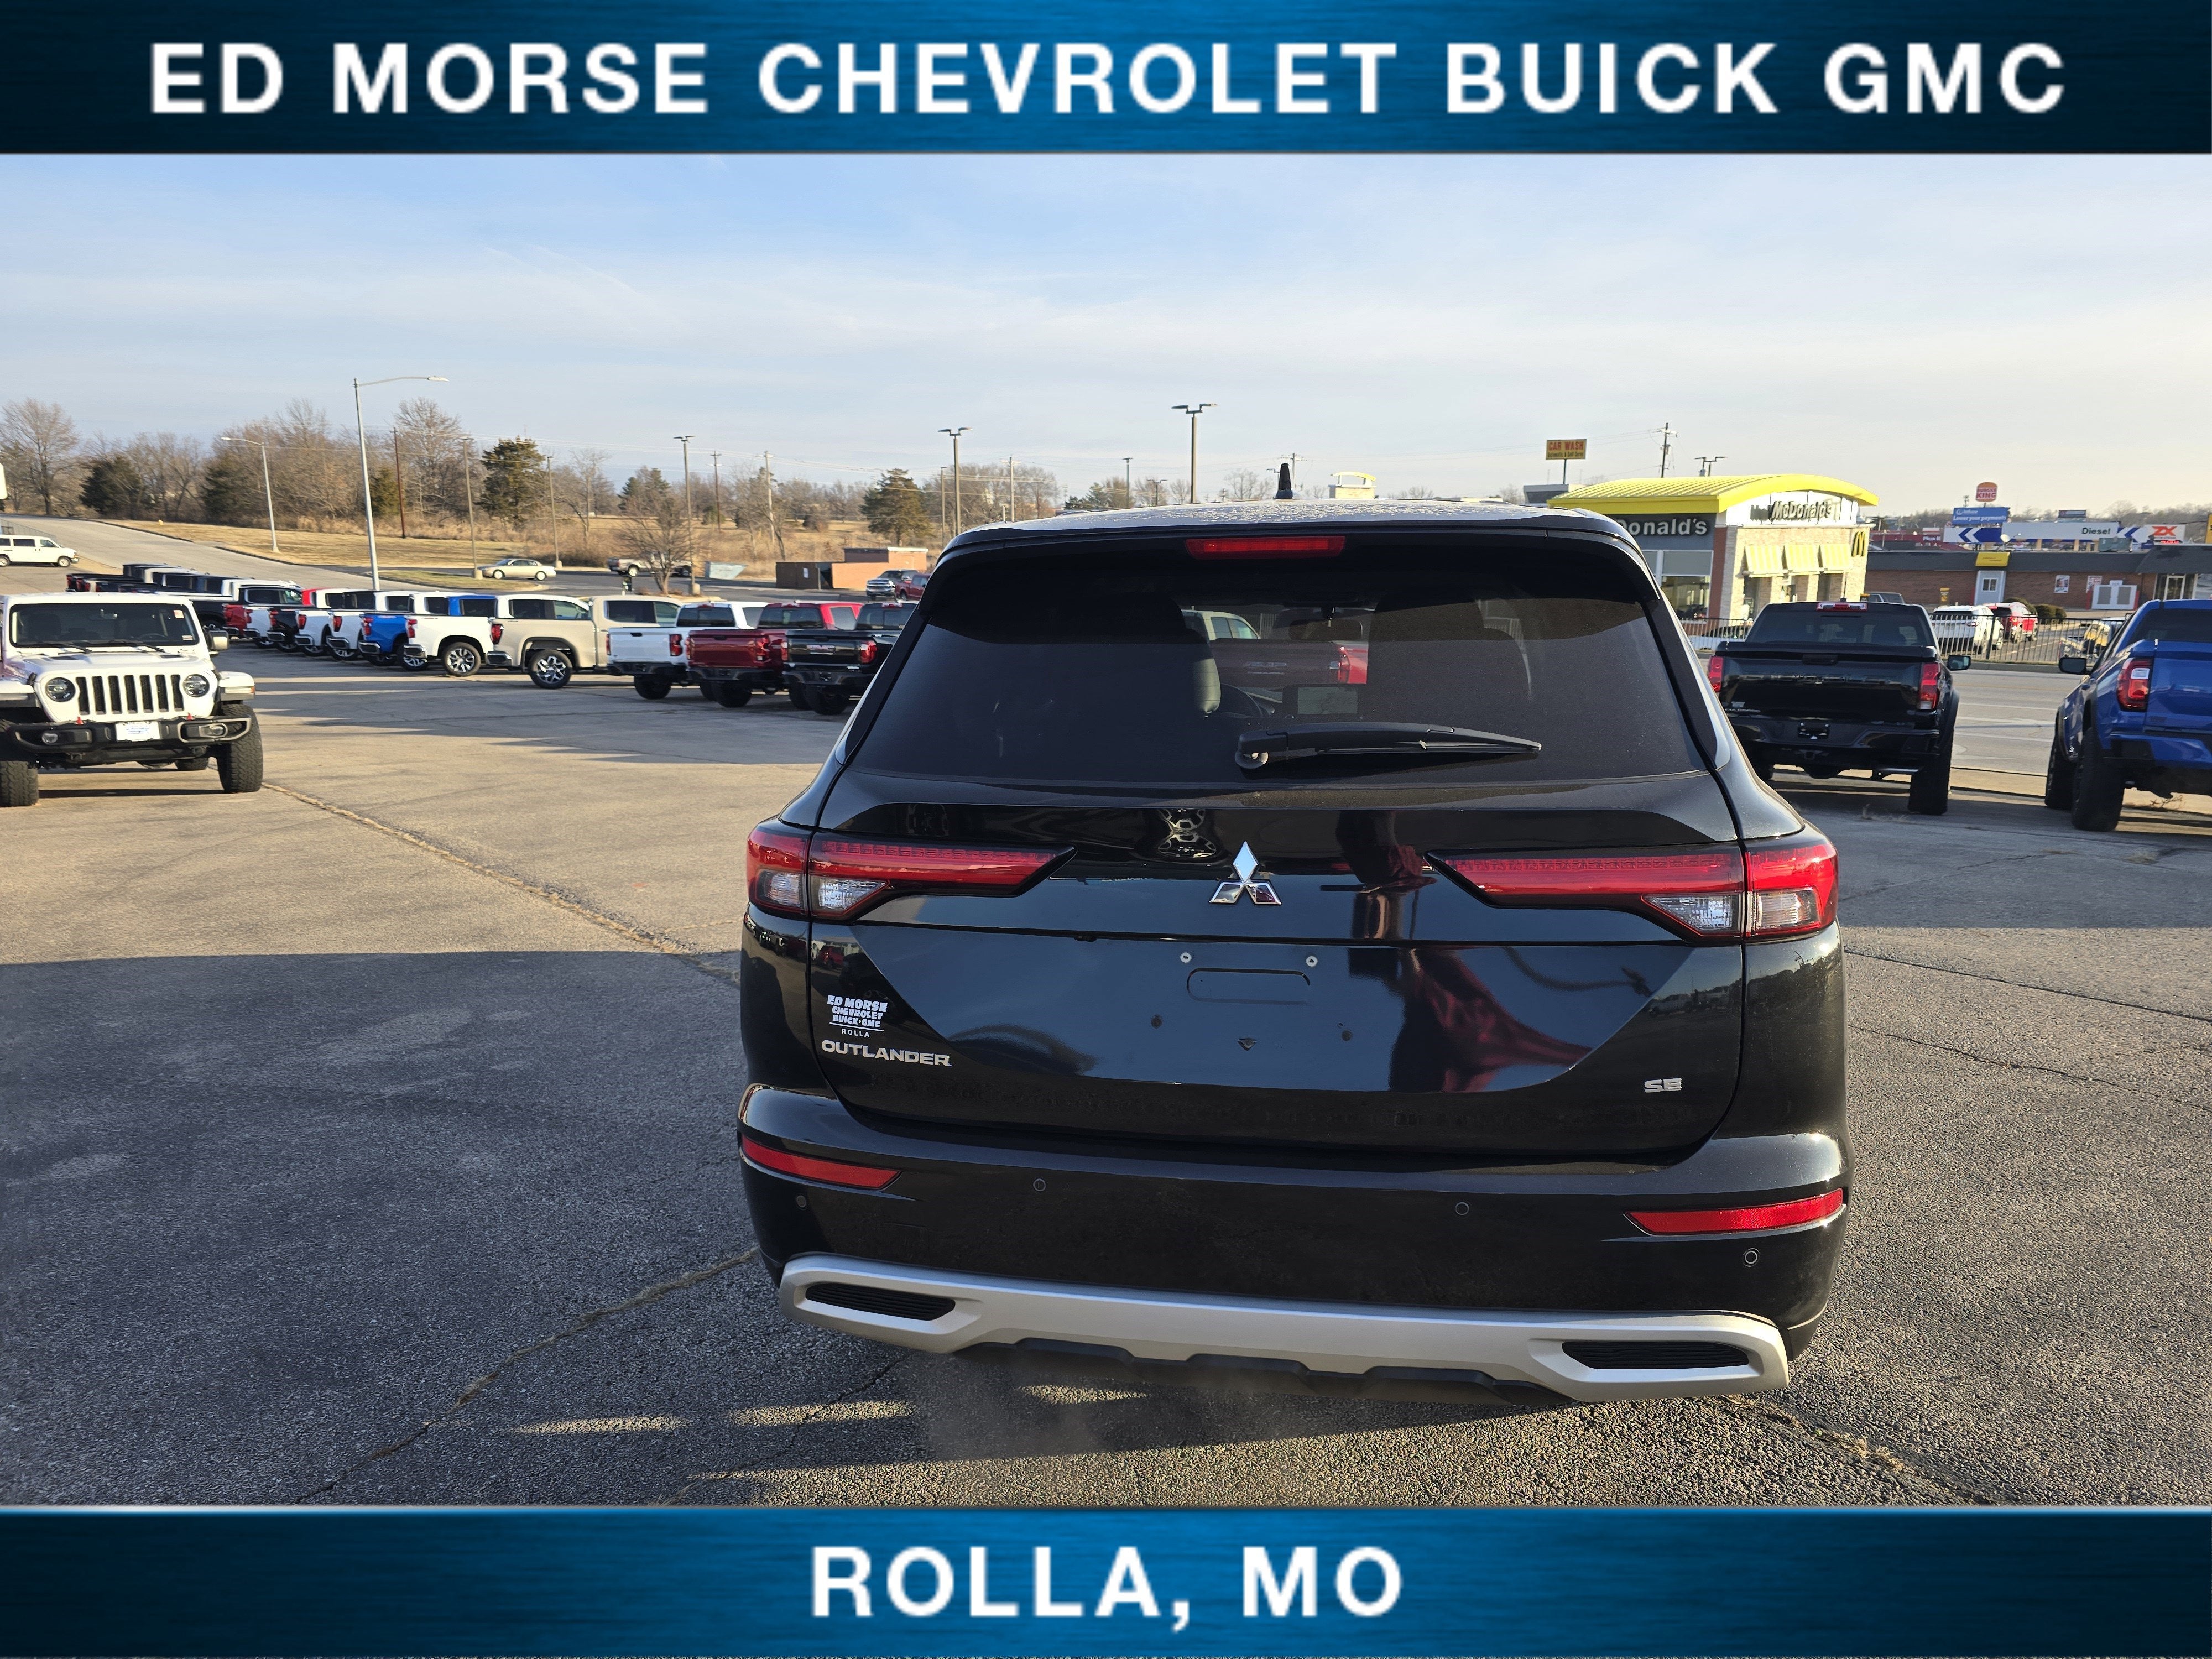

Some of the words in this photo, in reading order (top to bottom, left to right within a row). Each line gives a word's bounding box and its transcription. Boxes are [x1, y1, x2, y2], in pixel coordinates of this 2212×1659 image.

[1549, 442, 1561, 451] CAR
[1565, 441, 1584, 450] WASH
[1771, 500, 1832, 519] McDonald's
[2152, 525, 2177, 536] ZX
[827, 995, 843, 1006] ED
[844, 997, 888, 1013] MORSE
[832, 1006, 883, 1020] CHEVROLET
[841, 1028, 870, 1038] ROLLA
[822, 1040, 952, 1067] OUTLANDER
[1644, 1078, 1682, 1093] SE
